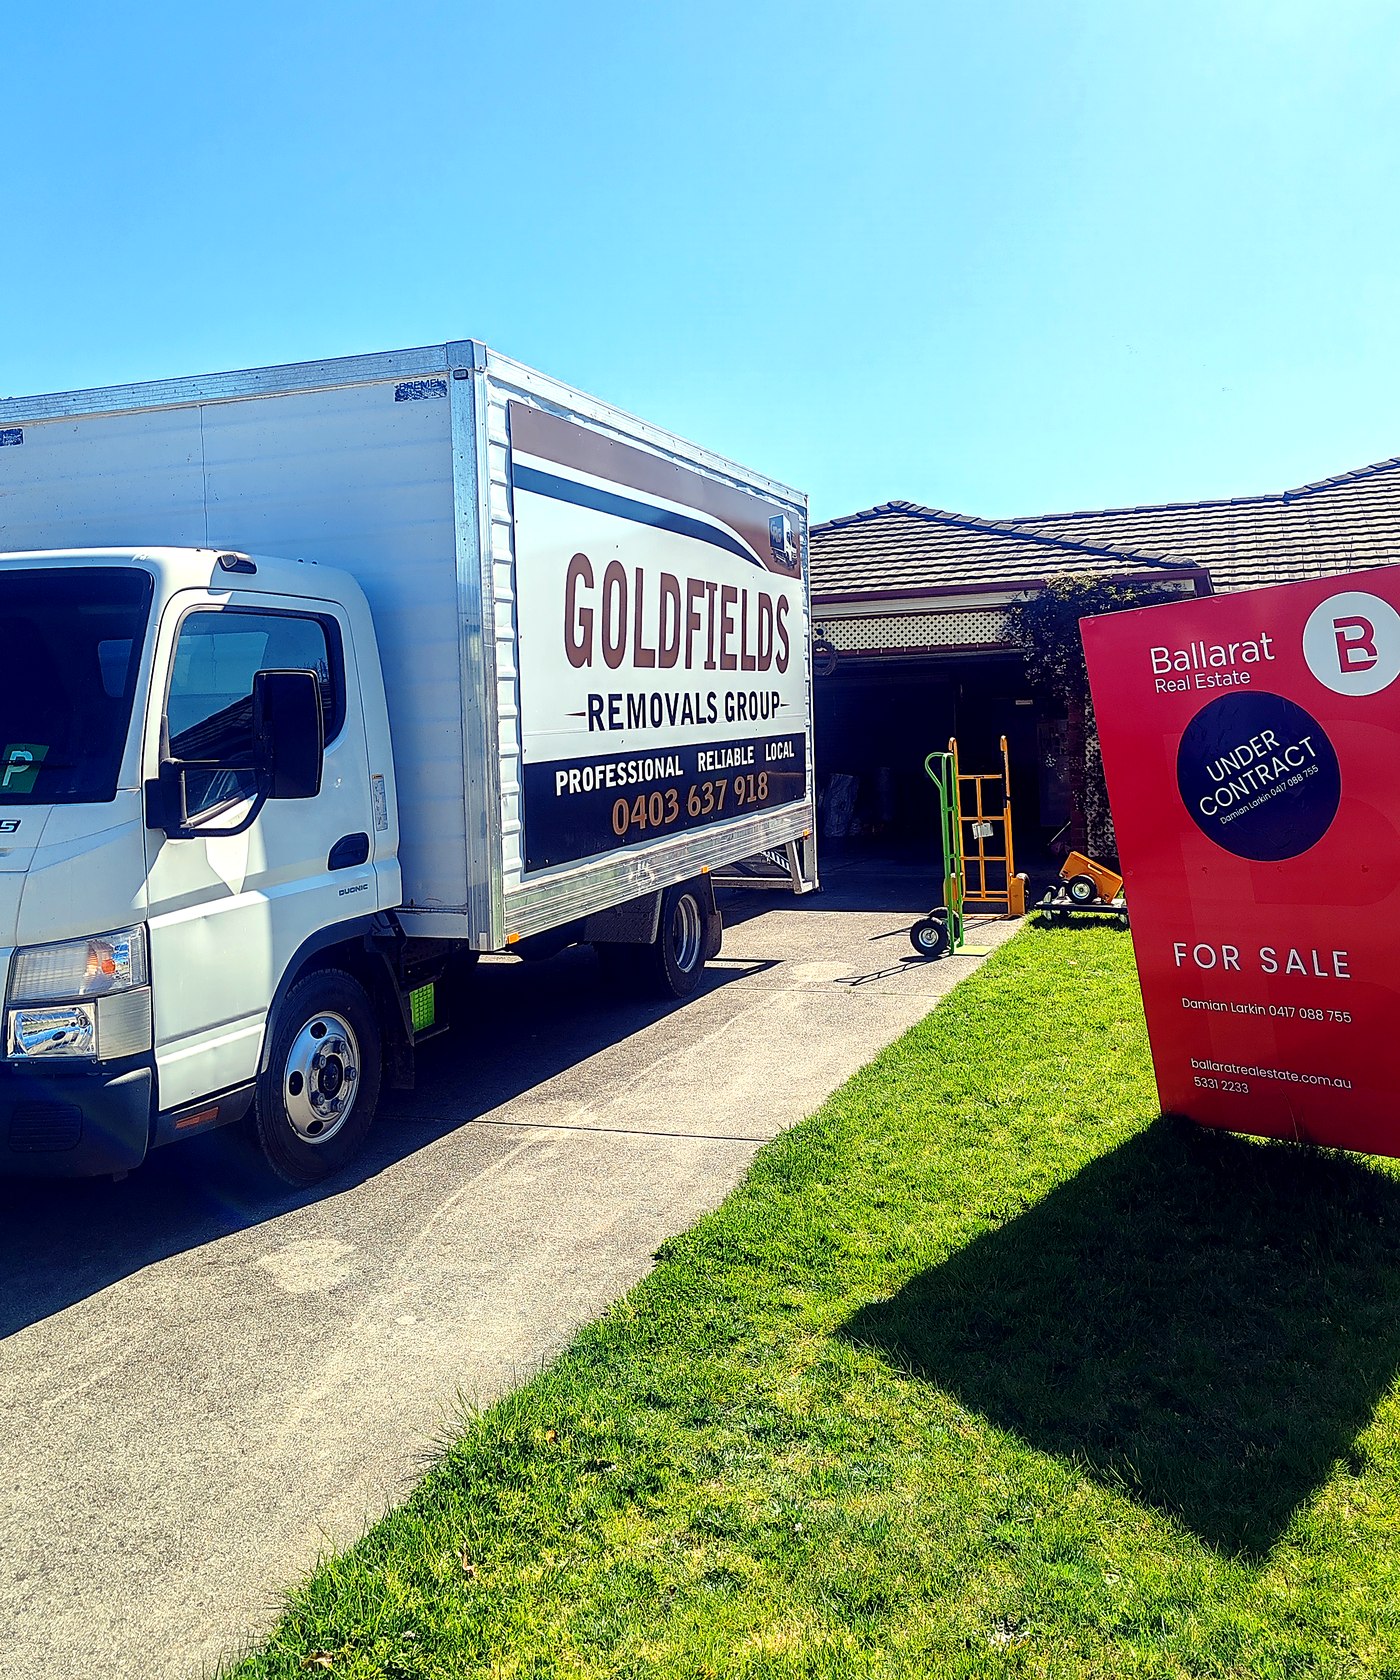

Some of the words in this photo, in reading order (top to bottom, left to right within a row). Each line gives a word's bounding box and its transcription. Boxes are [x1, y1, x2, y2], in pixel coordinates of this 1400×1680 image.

[564, 552, 790, 675] GOLDFIELDS
[1150, 632, 1275, 674] Ballarat
[1332, 615, 1378, 674] B
[1155, 674, 1191, 694] Real
[1195, 670, 1251, 690] Estate
[587, 691, 718, 732] REMOVALS
[725, 691, 780, 723] GROUP
[2, 750, 33, 786] P
[556, 755, 684, 796] PROFESSIONAL
[697, 746, 755, 772] RELIABLE
[765, 740, 795, 762] LOCAL
[1199, 736, 1316, 816] CONTRACT
[1206, 729, 1281, 782] UNDER
[612, 788, 680, 836] 0403
[687, 779, 728, 817] 637
[734, 771, 769, 806] 918
[1219, 804, 1250, 825] Damian
[1248, 793, 1272, 810] Larkin
[1270, 782, 1288, 797] 0417
[1287, 773, 1304, 787] 088
[1302, 764, 1319, 778] 755
[338, 884, 369, 896] DUONIC
[1173, 942, 1241, 971] FOR
[1259, 946, 1351, 979] SALE
[1182, 997, 1228, 1012] Damian
[1230, 1002, 1266, 1016] Larkin
[1269, 1005, 1296, 1018] 0417
[1299, 1008, 1324, 1021] 088
[1326, 1010, 1352, 1024] 755
[1190, 1058, 1352, 1090] ballaratrealestate.com.au
[1194, 1076, 1219, 1090] 5331
[1221, 1080, 1249, 1094] 2233
